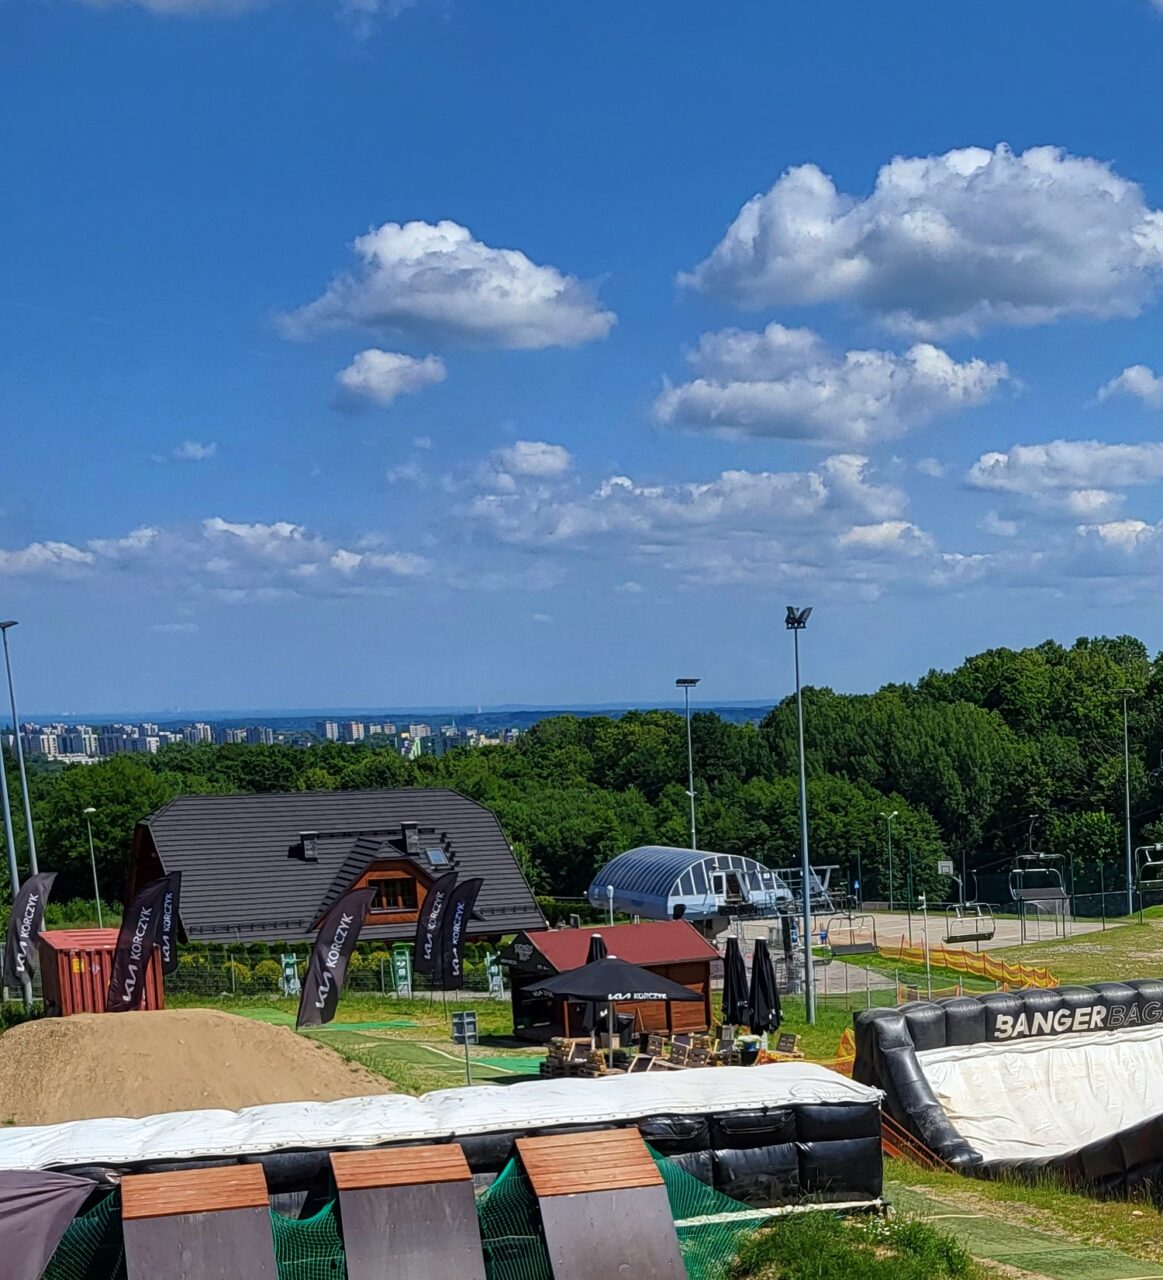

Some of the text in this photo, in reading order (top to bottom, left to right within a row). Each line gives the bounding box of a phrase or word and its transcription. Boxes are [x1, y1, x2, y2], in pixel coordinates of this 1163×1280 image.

[20, 893, 39, 939] KORCZYK
[130, 906, 153, 961] KORCZYK
[163, 892, 173, 932] KORCZYK
[427, 891, 446, 931] KORCZYK
[452, 902, 465, 946] KORCZYK
[326, 912, 354, 968] KORCZYK
